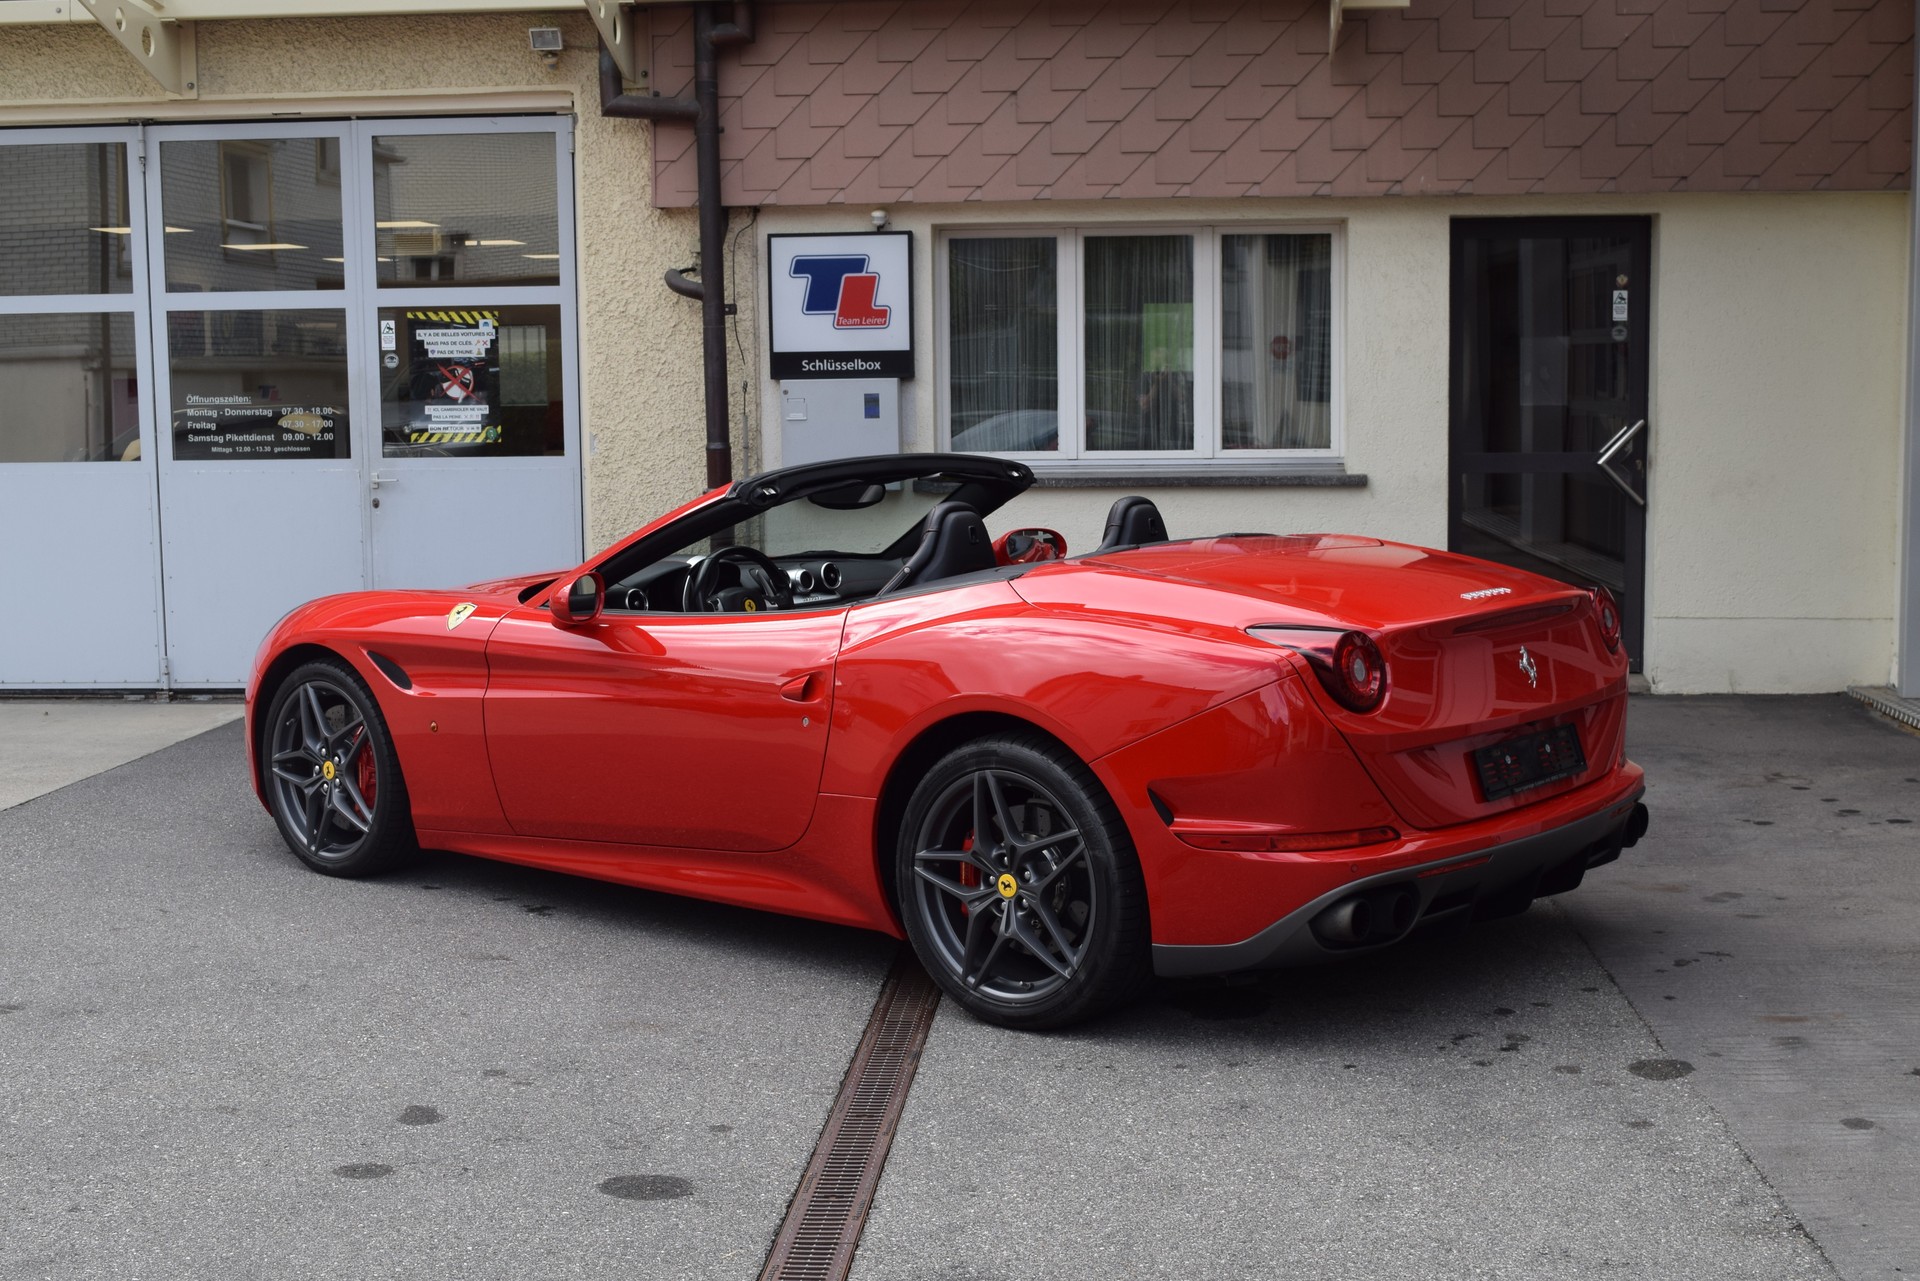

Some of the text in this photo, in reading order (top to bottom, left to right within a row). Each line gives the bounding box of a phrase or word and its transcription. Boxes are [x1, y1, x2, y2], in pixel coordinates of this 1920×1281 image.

[789, 254, 892, 330] TL
[839, 316, 886, 325] Team Leirer
[802, 359, 881, 371] Schlüsselbox
[186, 394, 252, 404] Öffnungszeiten:
[187, 408, 218, 418] Montag
[224, 408, 273, 417] Donnerstag
[311, 407, 333, 415] 18.00
[187, 422, 216, 430] Freitag
[312, 420, 334, 428] 17.00
[188, 434, 224, 443] Samstag
